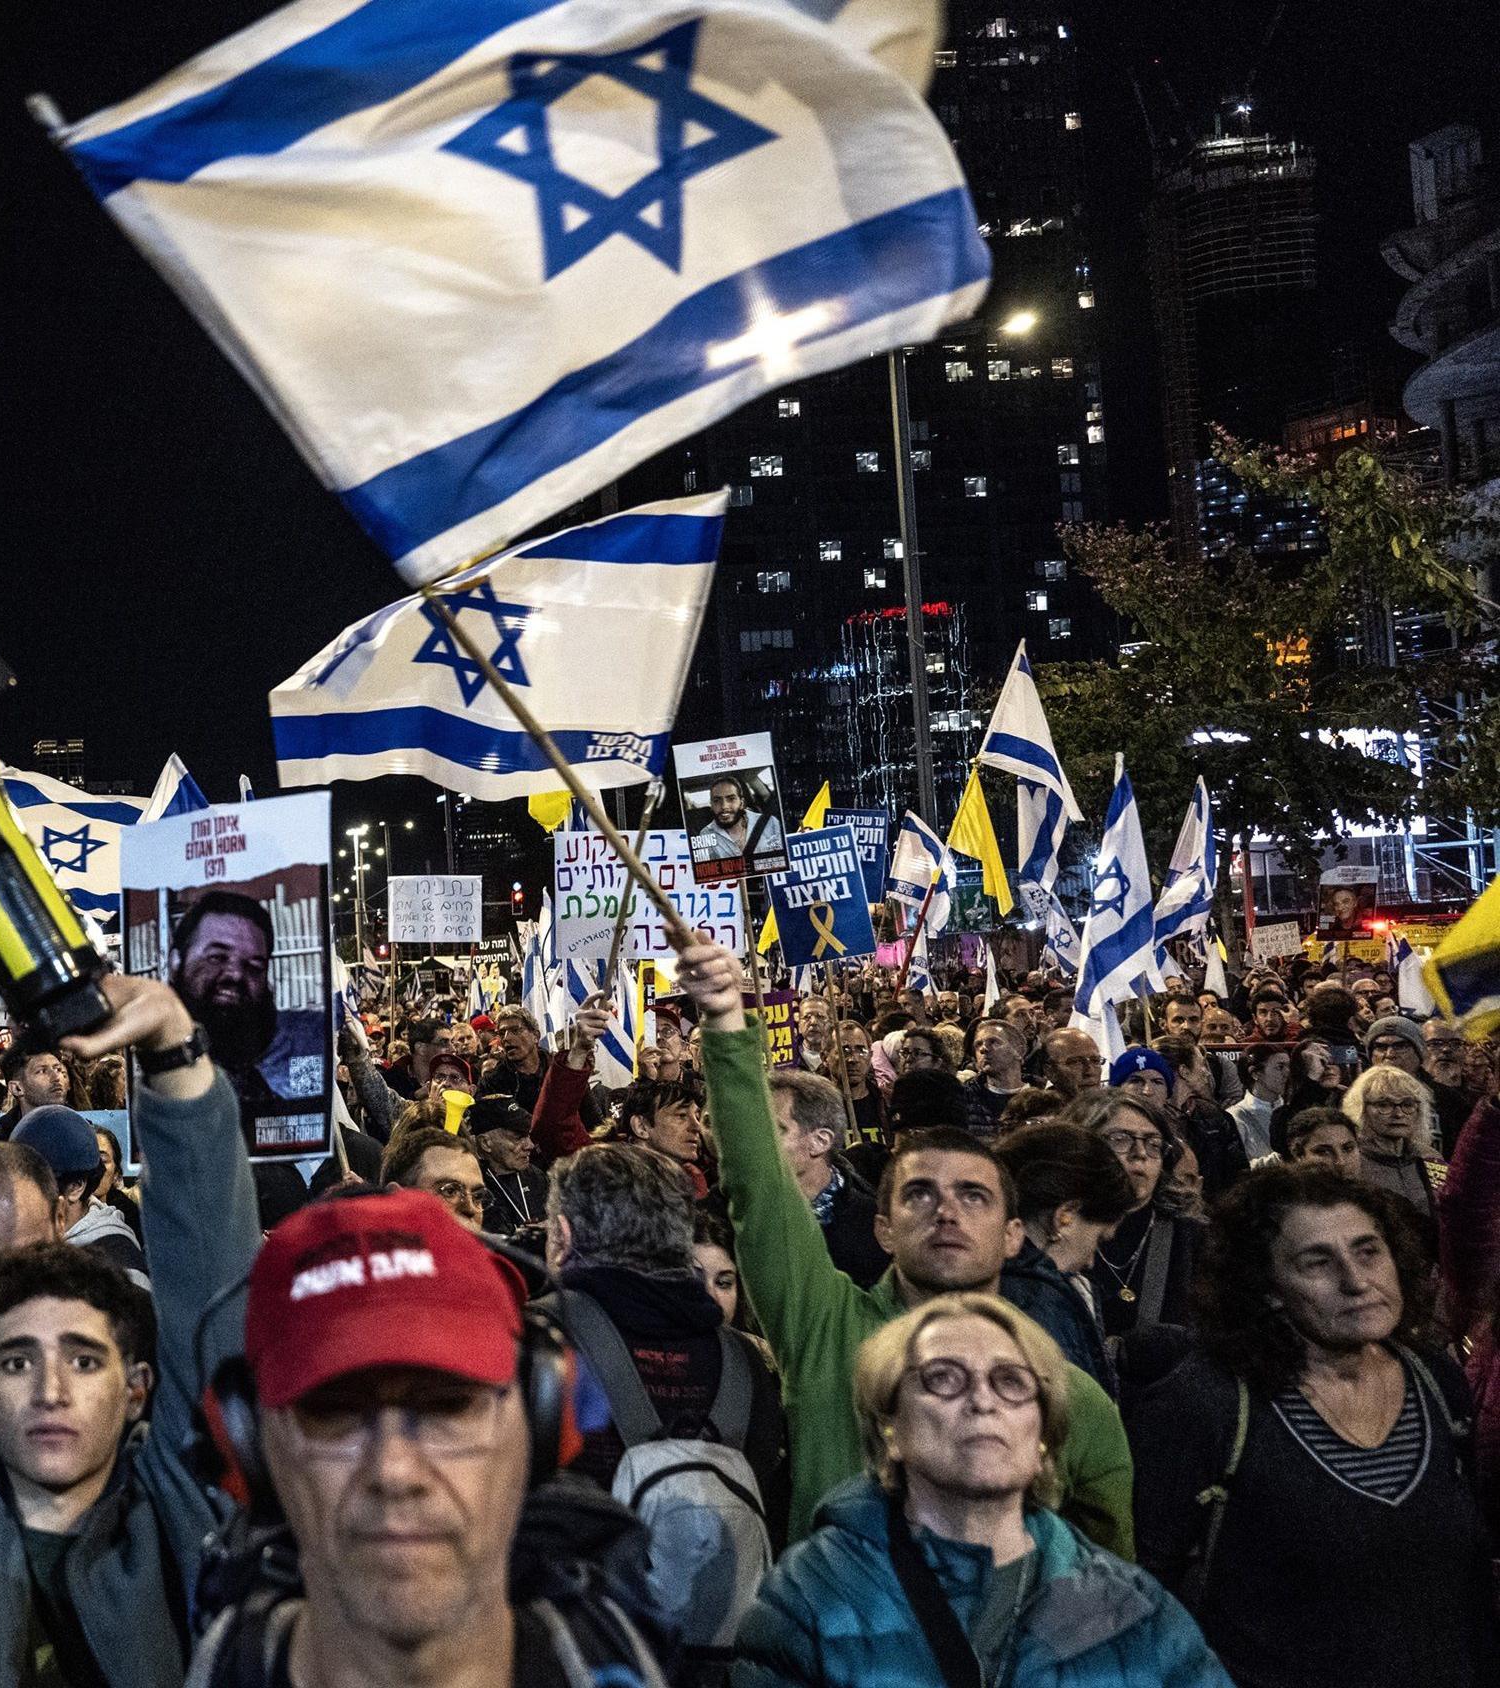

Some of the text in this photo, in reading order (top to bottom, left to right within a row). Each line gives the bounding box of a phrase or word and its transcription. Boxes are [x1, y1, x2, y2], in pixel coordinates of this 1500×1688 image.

[845, 814, 873, 825] שכולם
[875, 816, 885, 826] עד
[185, 834, 246, 860] EITAN HORN
[691, 834, 717, 849] BRING
[791, 835, 850, 858] עד שכולם
[694, 848, 711, 862] HIM
[204, 857, 226, 878] (37)
[416, 880, 474, 897] נתניהו
[783, 877, 852, 908] בארצנו
[479, 939, 507, 950] ומה עם
[255, 1123, 325, 1145] FAMILIES FORUM
